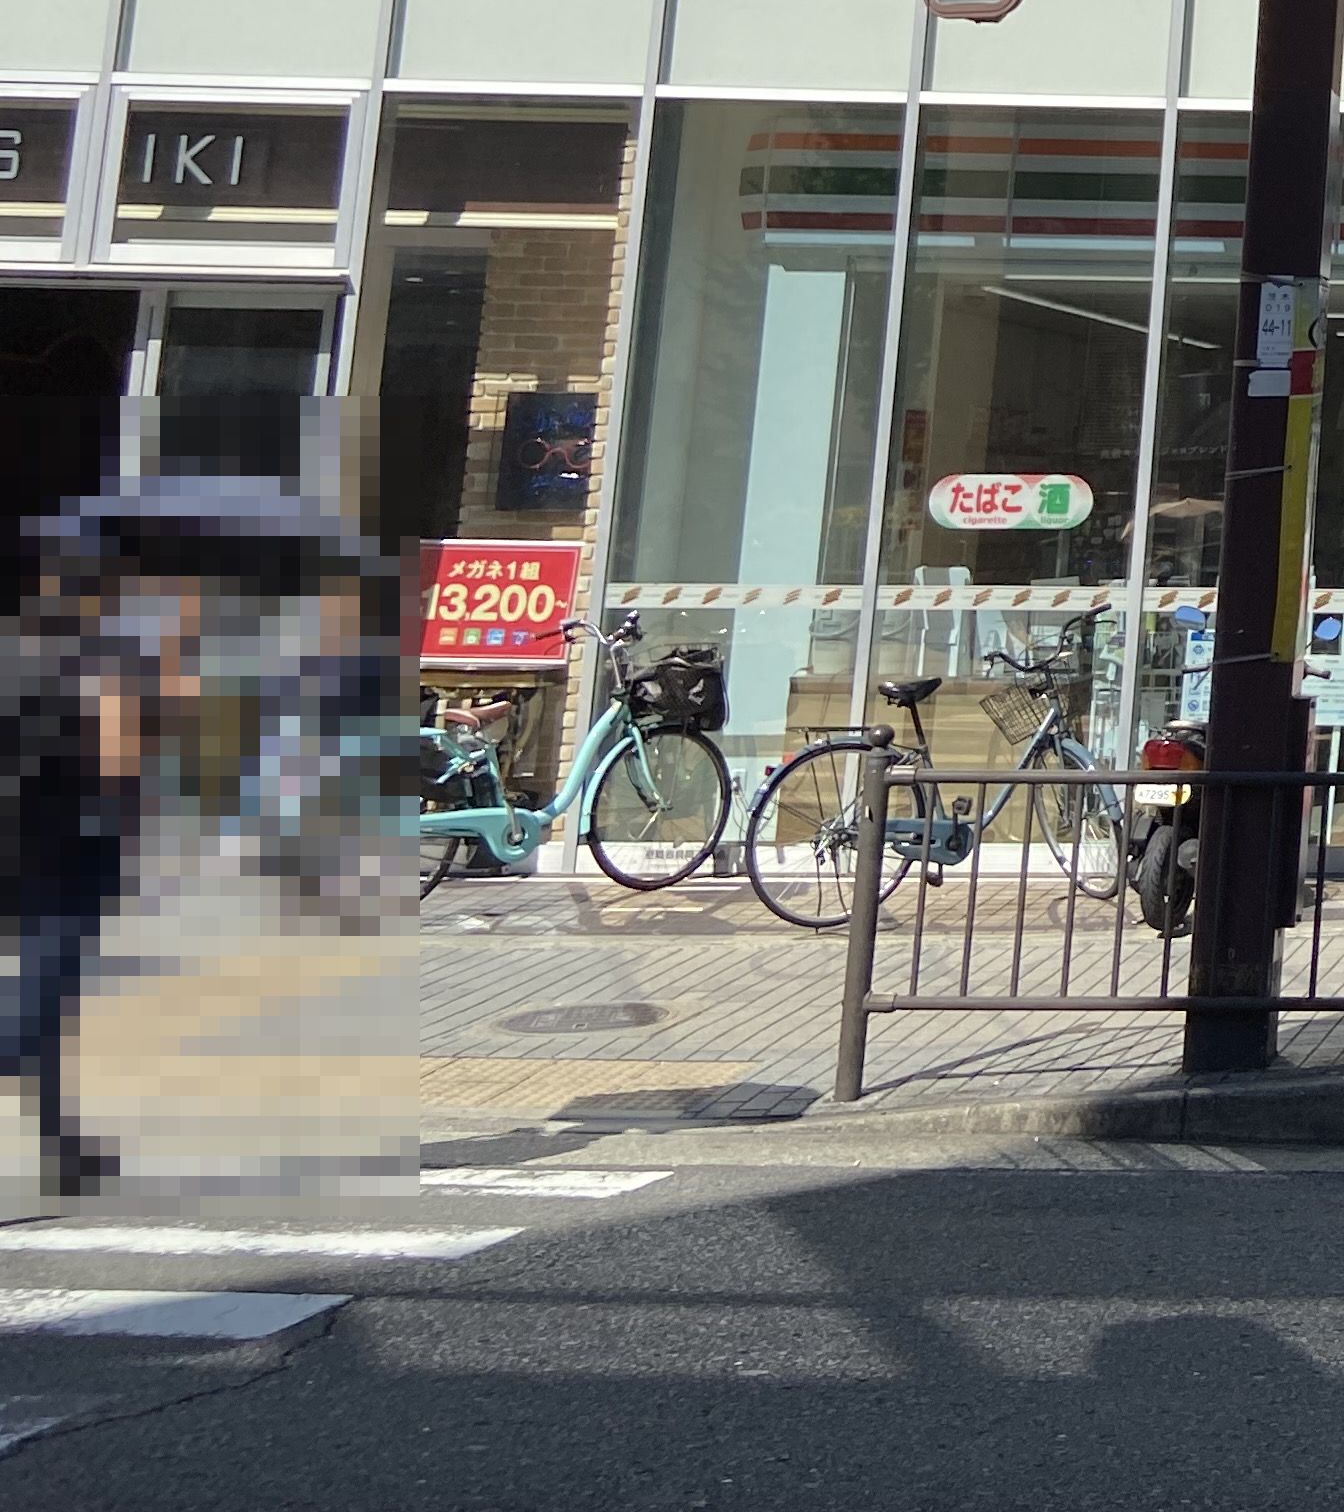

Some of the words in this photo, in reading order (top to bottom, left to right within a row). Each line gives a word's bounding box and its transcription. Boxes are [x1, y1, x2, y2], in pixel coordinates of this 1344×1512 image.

[142, 133, 244, 186] IKI
[949, 482, 1023, 514] たばこ
[1038, 483, 1071, 515] 酒
[962, 516, 1008, 526] cigarette
[447, 559, 542, 581] メガネ1組
